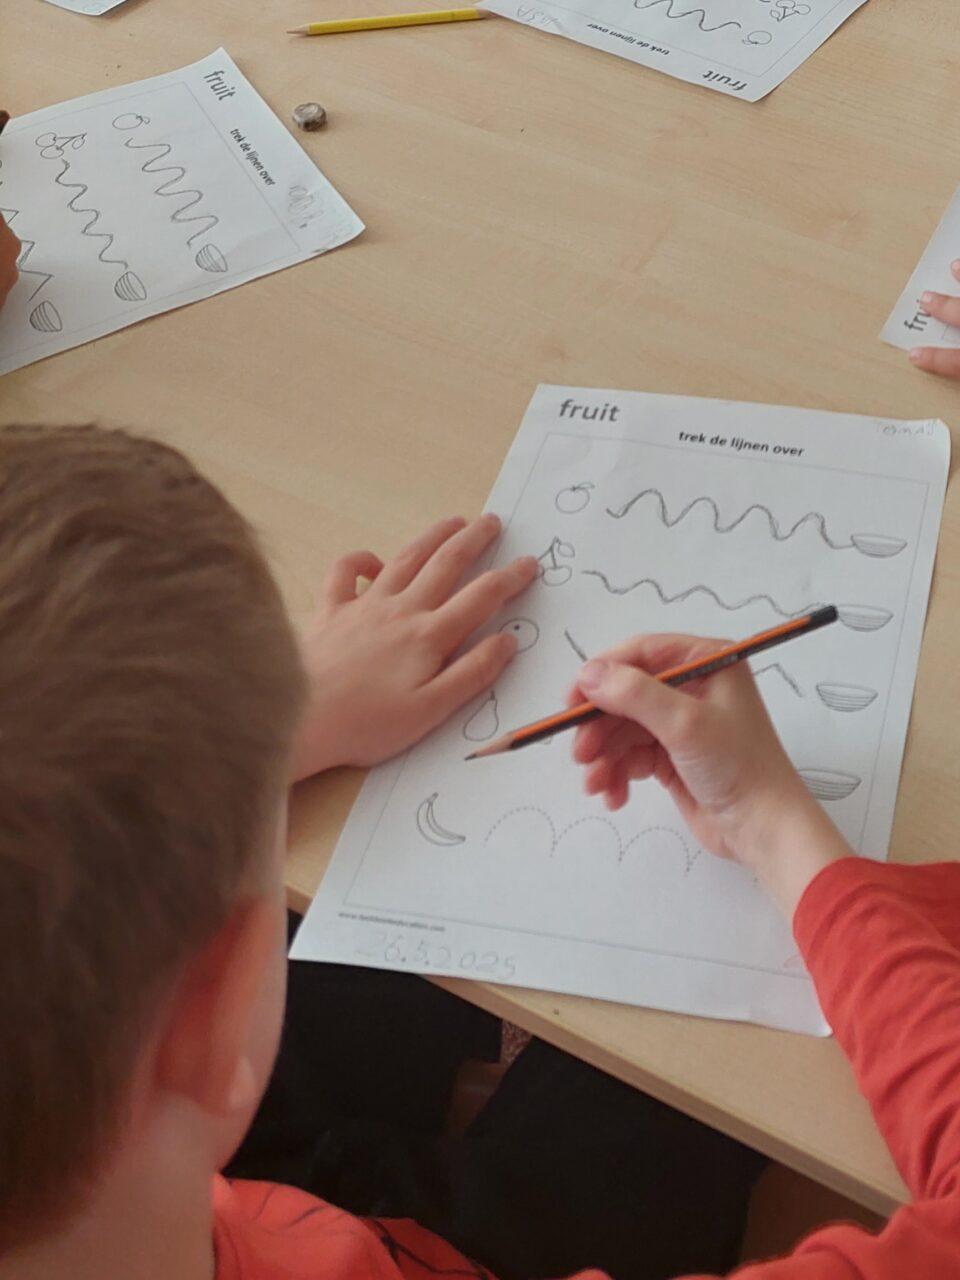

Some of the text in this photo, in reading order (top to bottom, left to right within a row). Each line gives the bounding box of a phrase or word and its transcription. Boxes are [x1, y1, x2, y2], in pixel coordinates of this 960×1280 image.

[587, 23, 670, 55] trek de lijnen over
[204, 70, 236, 101] fruit
[702, 70, 748, 91] fruit
[230, 128, 276, 186] trek de lijnen over
[558, 398, 621, 422] fruit
[678, 431, 805, 457] trek de lijnen over
